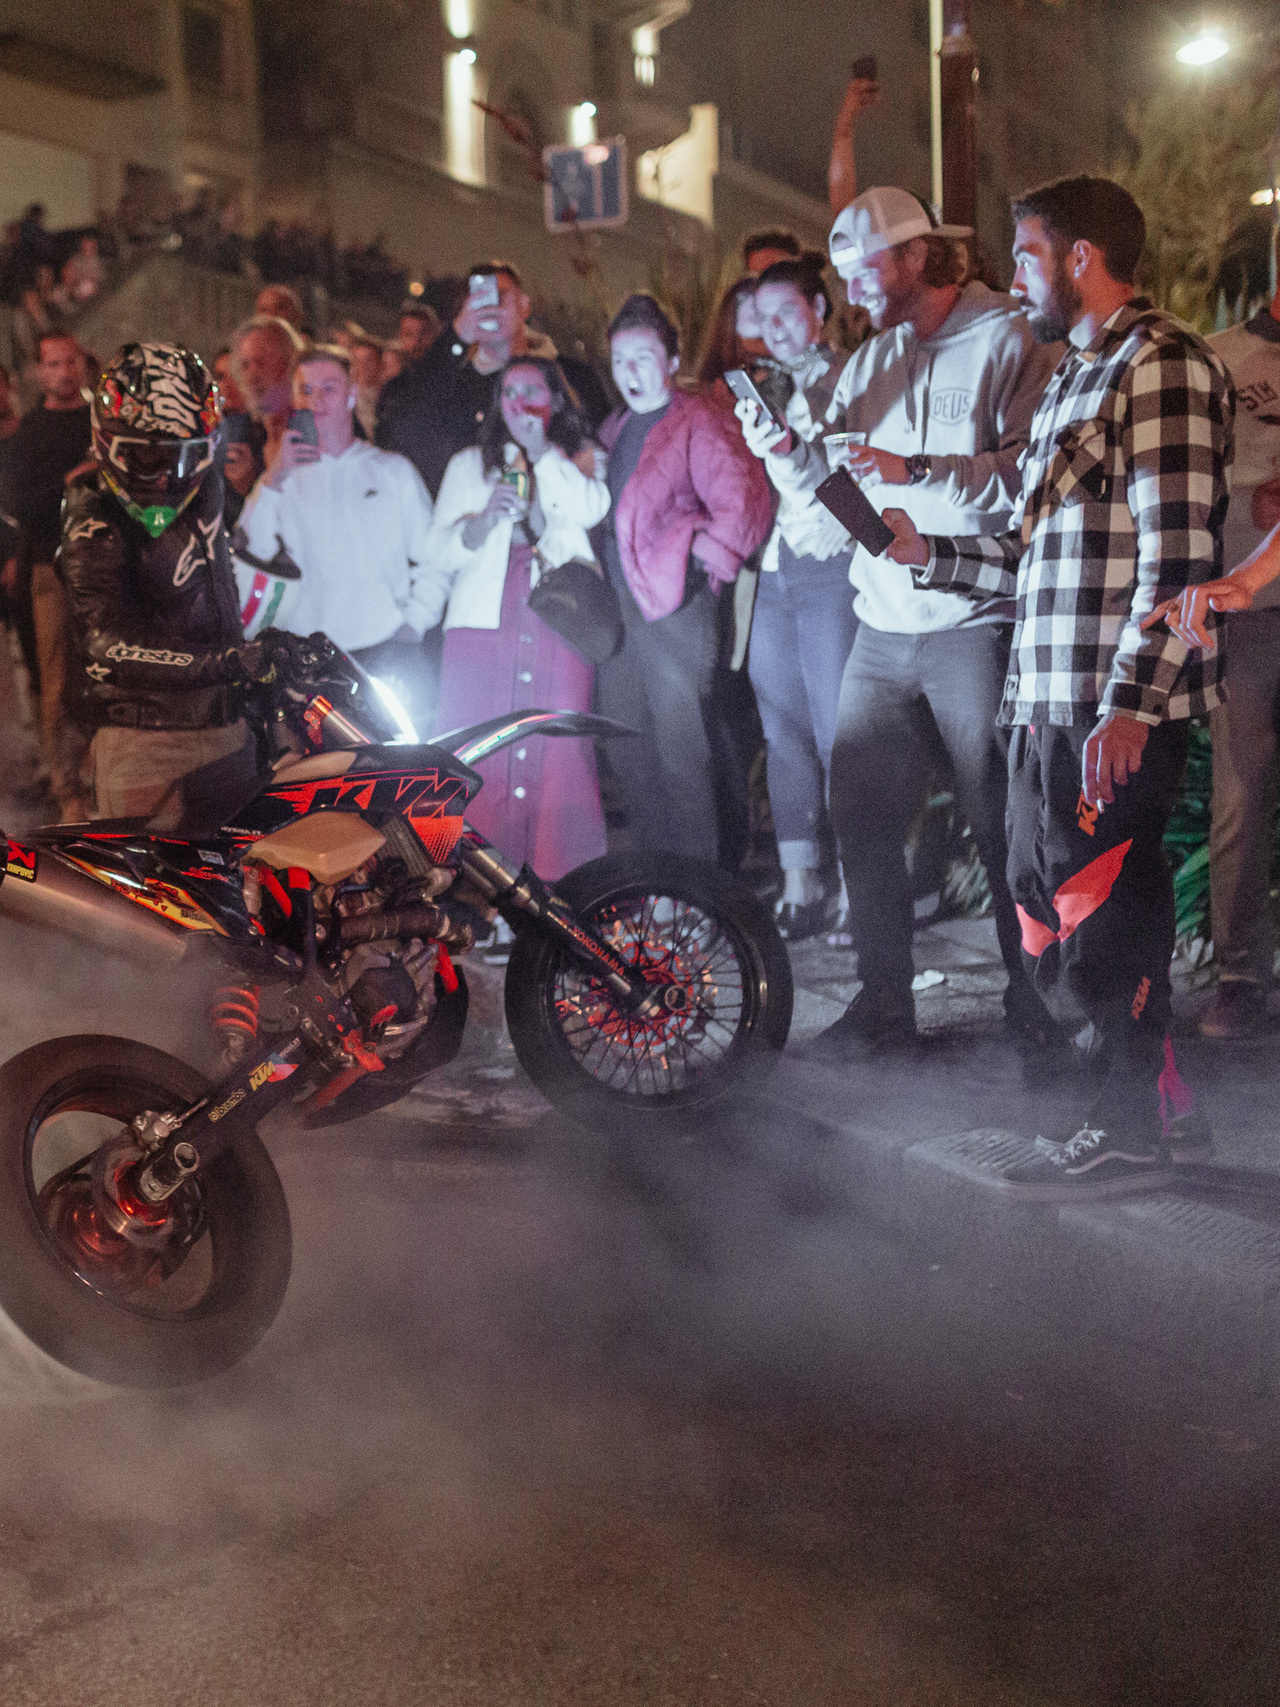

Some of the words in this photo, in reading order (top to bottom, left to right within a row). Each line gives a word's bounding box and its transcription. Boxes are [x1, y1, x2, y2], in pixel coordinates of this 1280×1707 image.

[933, 394, 970, 419] DEUS
[307, 770, 469, 819] KTM
[1076, 788, 1100, 836] KT
[572, 927, 625, 976] YOKOHAMA
[1131, 976, 1151, 1019] KTM
[249, 1061, 276, 1091] KTM
[217, 1088, 246, 1118] brembo
